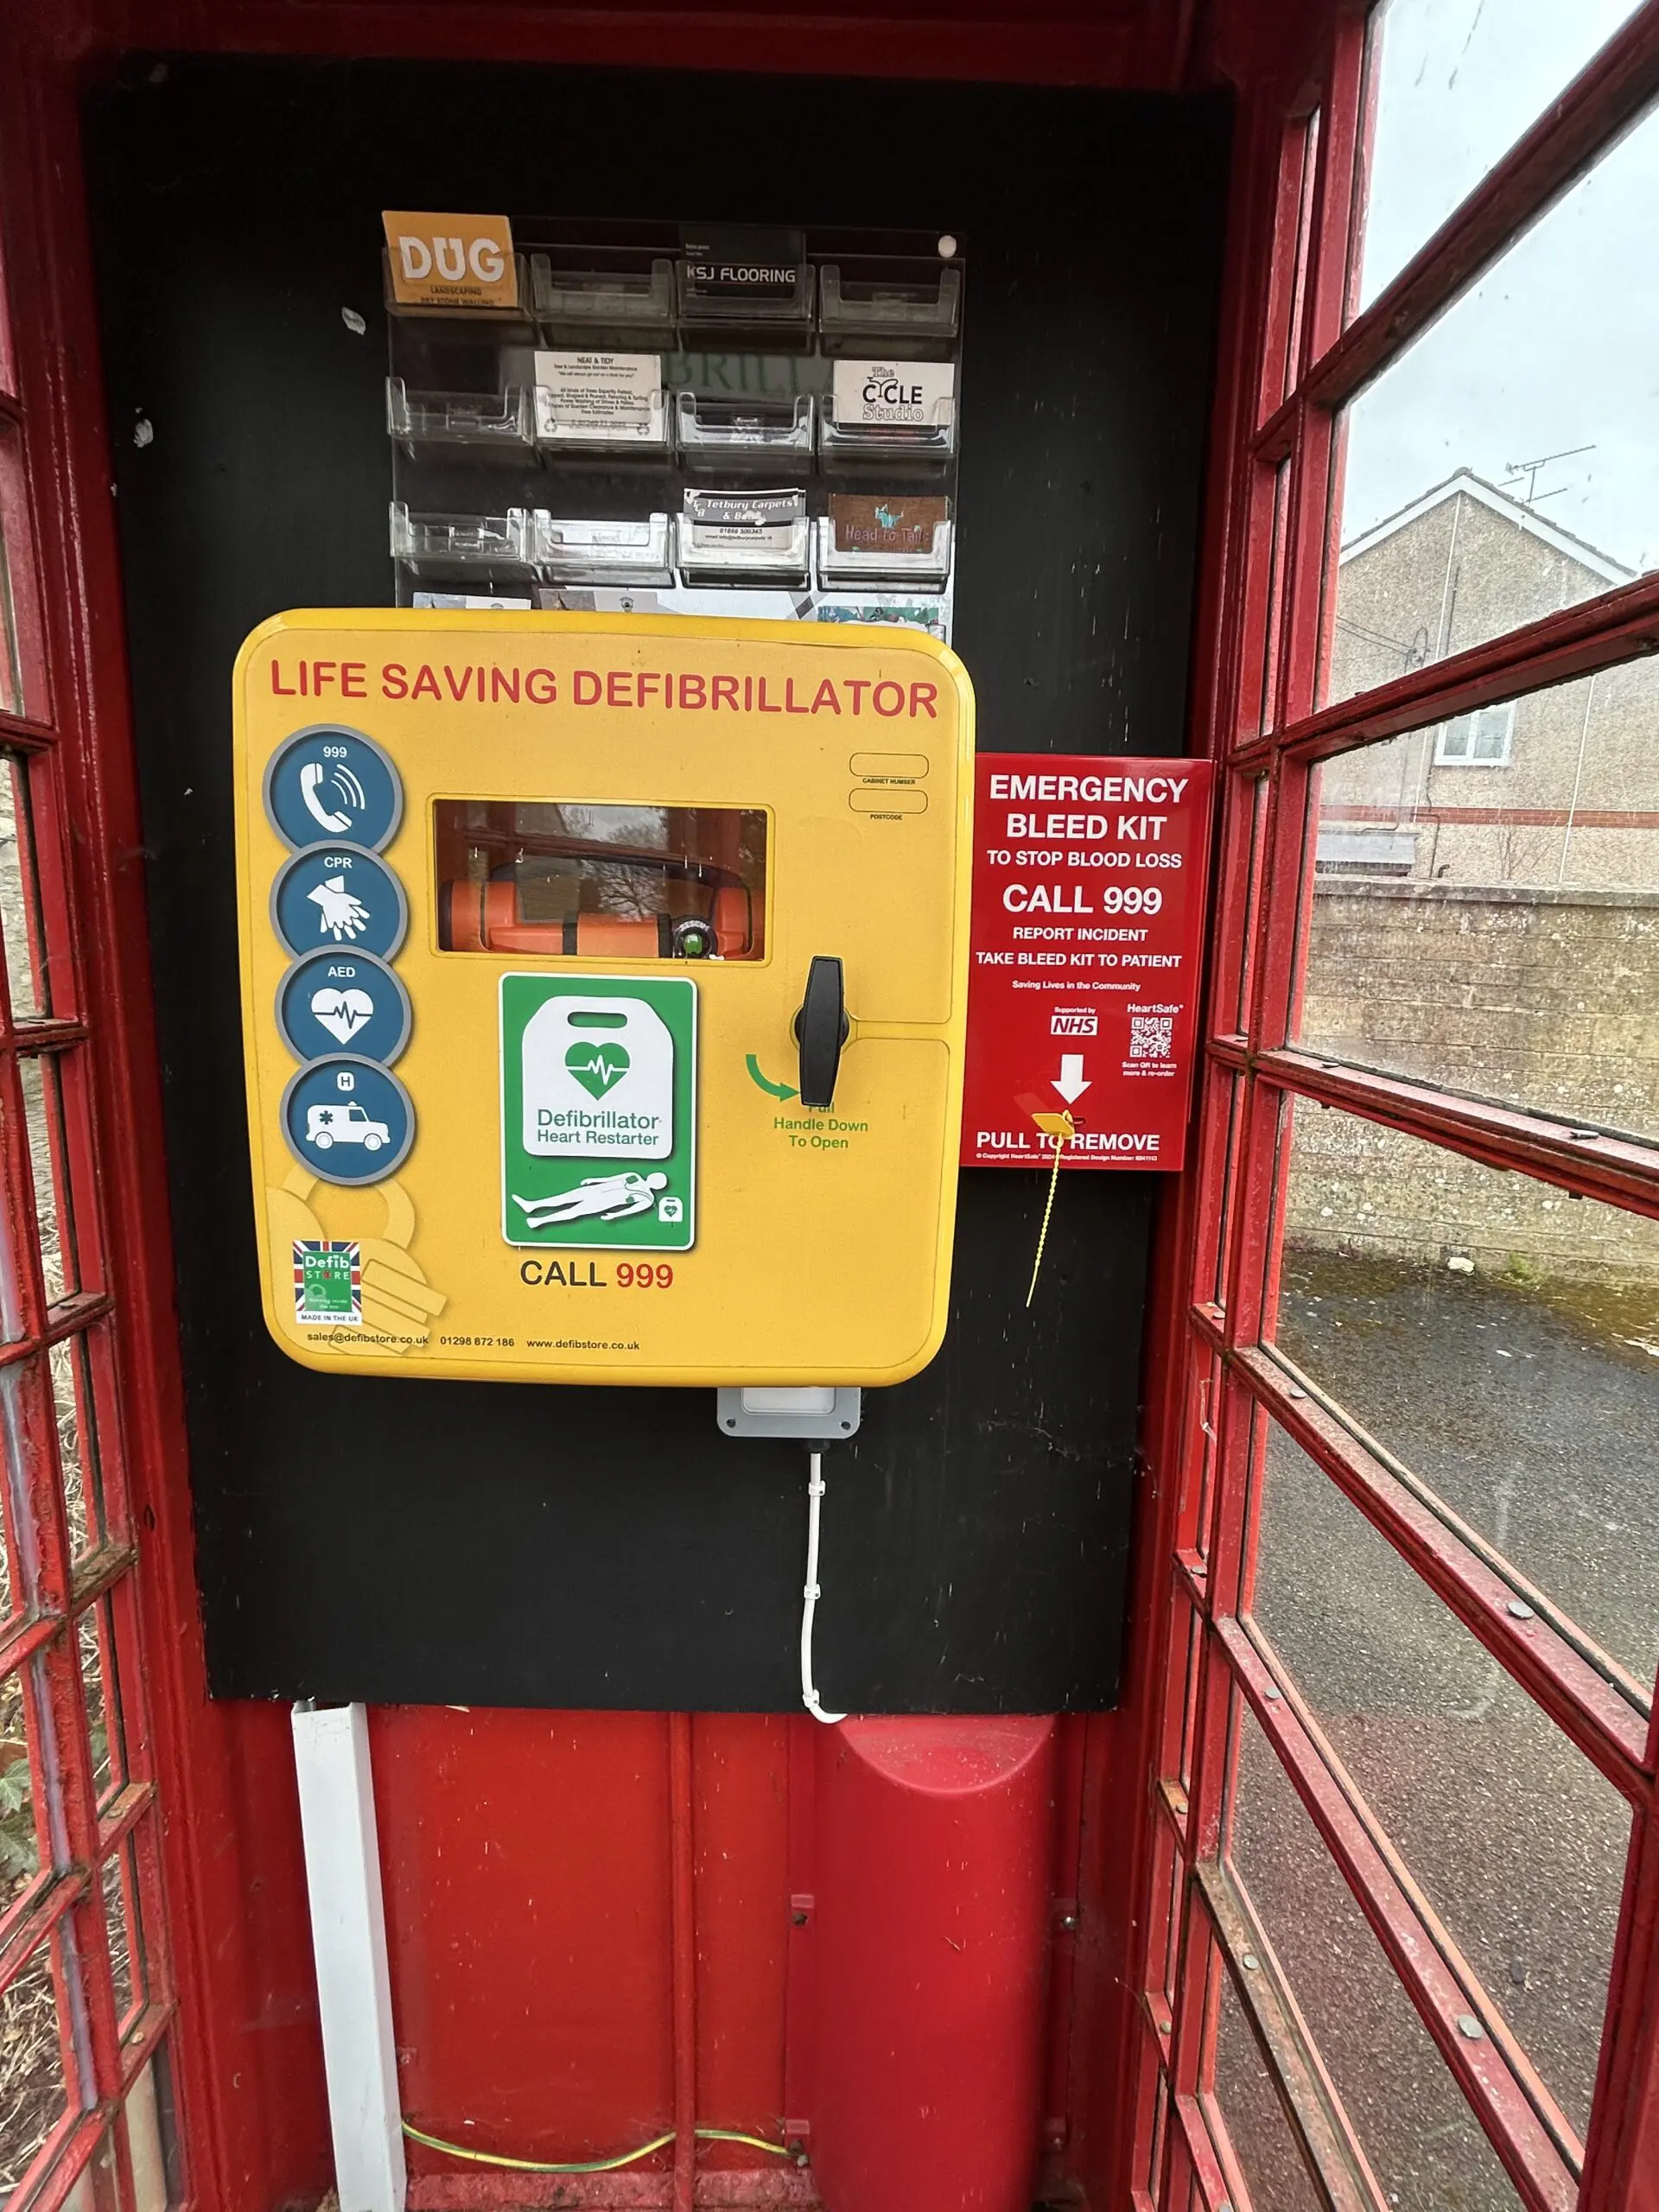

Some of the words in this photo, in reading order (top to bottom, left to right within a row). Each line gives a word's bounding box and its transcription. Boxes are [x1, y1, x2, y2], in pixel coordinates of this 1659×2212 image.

[398, 236, 505, 283] DUG
[687, 265, 715, 280] KSJ
[721, 268, 795, 283] FLOORING
[872, 366, 895, 378] The
[862, 377, 922, 404] CYCLE
[862, 404, 924, 422] Studio
[707, 499, 748, 510] Tetbury
[752, 499, 792, 510] Carpets
[723, 512, 731, 520] &
[845, 524, 878, 542] Head
[883, 529, 896, 542] to
[270, 659, 367, 697] LIFE
[381, 664, 557, 705] SAVING
[573, 670, 938, 719] DEFIBRILLATOR
[322, 746, 347, 759] 999
[989, 774, 1189, 803] EMERGENCY
[1007, 813, 1108, 839] BLEED
[1116, 815, 1167, 841] KIT
[324, 856, 353, 869] CPR
[987, 849, 1011, 865] TO
[1015, 850, 1063, 866] STOP
[1068, 851, 1130, 868] BLOOD
[1135, 853, 1182, 868] LOSS
[1002, 883, 1093, 913] CALL
[1103, 886, 1163, 915] 999
[1013, 927, 1074, 940] REPORT
[1077, 928, 1148, 942] INCIDENT
[976, 951, 1014, 965] TAKE
[1018, 952, 1067, 966] BLEED
[1071, 953, 1095, 966] KIT
[1098, 954, 1118, 967] TO
[1122, 955, 1182, 968] PATIENT
[327, 966, 356, 978] AED
[1012, 980, 1041, 990] Saving
[1042, 980, 1065, 989] Lives
[1066, 981, 1076, 989] in
[1077, 982, 1090, 990] the
[1092, 982, 1141, 992] Community
[1052, 1017, 1096, 1033] NHS
[537, 1109, 659, 1129] Defibrillator
[773, 1117, 824, 1131] Handle
[828, 1119, 868, 1132] Down
[537, 1129, 581, 1143] Heart
[586, 1130, 659, 1146] Restarter
[789, 1135, 807, 1147] To
[810, 1136, 849, 1150] Open
[976, 1132, 1030, 1148] PULL
[1070, 1133, 1160, 1151] REMOVE
[305, 1255, 350, 1268] Defib
[520, 1260, 607, 1287] CALL
[616, 1262, 674, 1288] 999
[307, 1332, 429, 1345] sales@defibstore.co.uk
[440, 1336, 472, 1346] 01298
[474, 1337, 494, 1347] 872
[496, 1338, 515, 1348] 186
[526, 1338, 640, 1351] www.defibstore.co.uk
